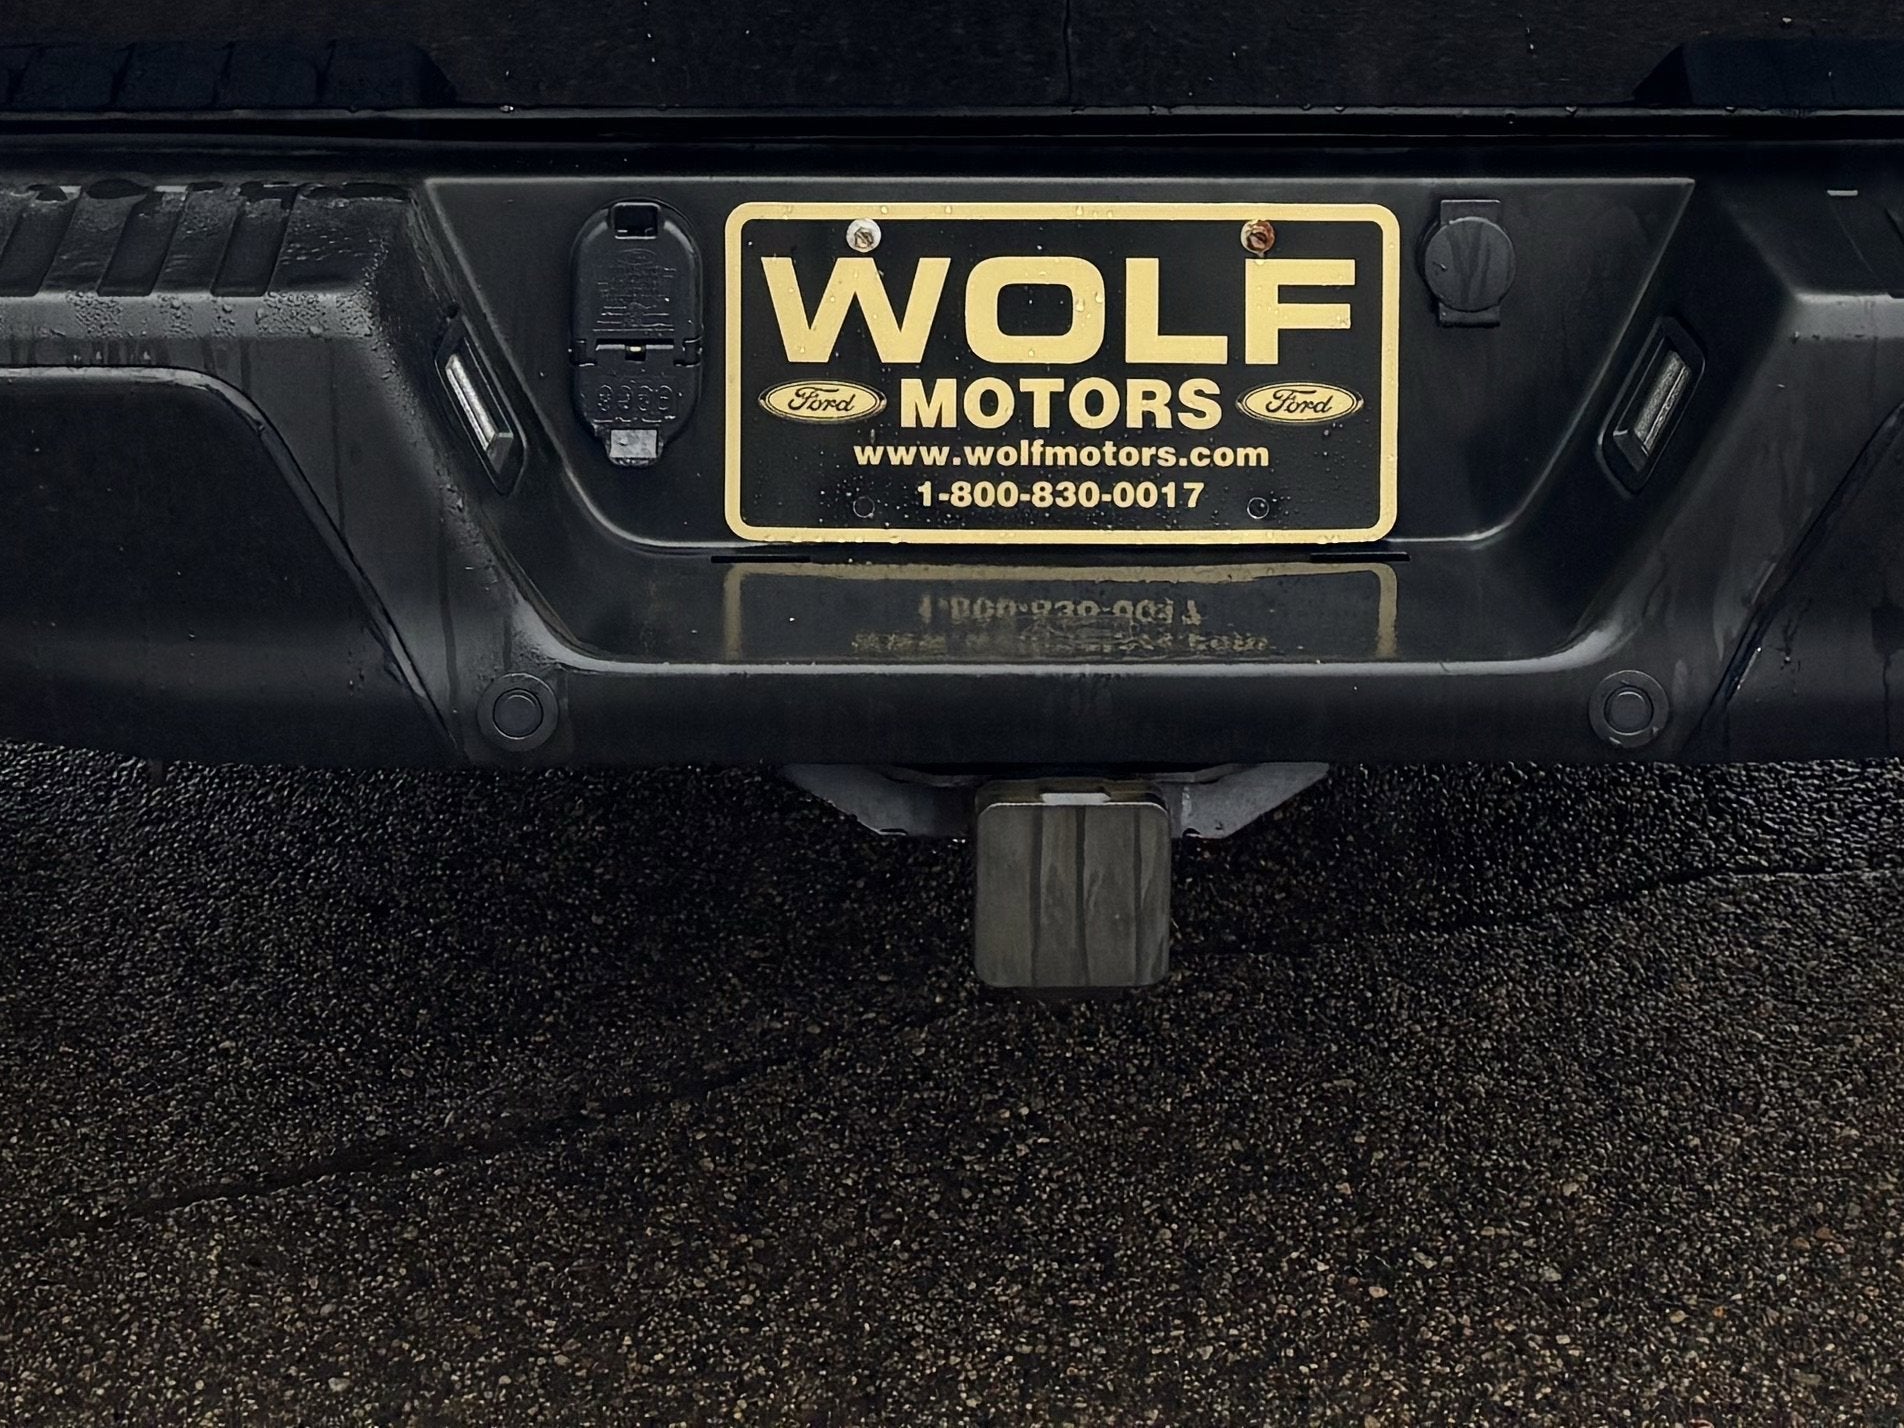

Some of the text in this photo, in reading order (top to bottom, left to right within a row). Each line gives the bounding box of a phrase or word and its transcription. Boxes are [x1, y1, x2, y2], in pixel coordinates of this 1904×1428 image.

[760, 255, 1356, 365] WOLF
[787, 386, 857, 412] Ford
[900, 376, 1222, 430] MOTORS
[1265, 388, 1334, 414] Ford
[853, 438, 1269, 468] www.wolfmotors.com
[916, 480, 1205, 509] 1-800-830-0017
